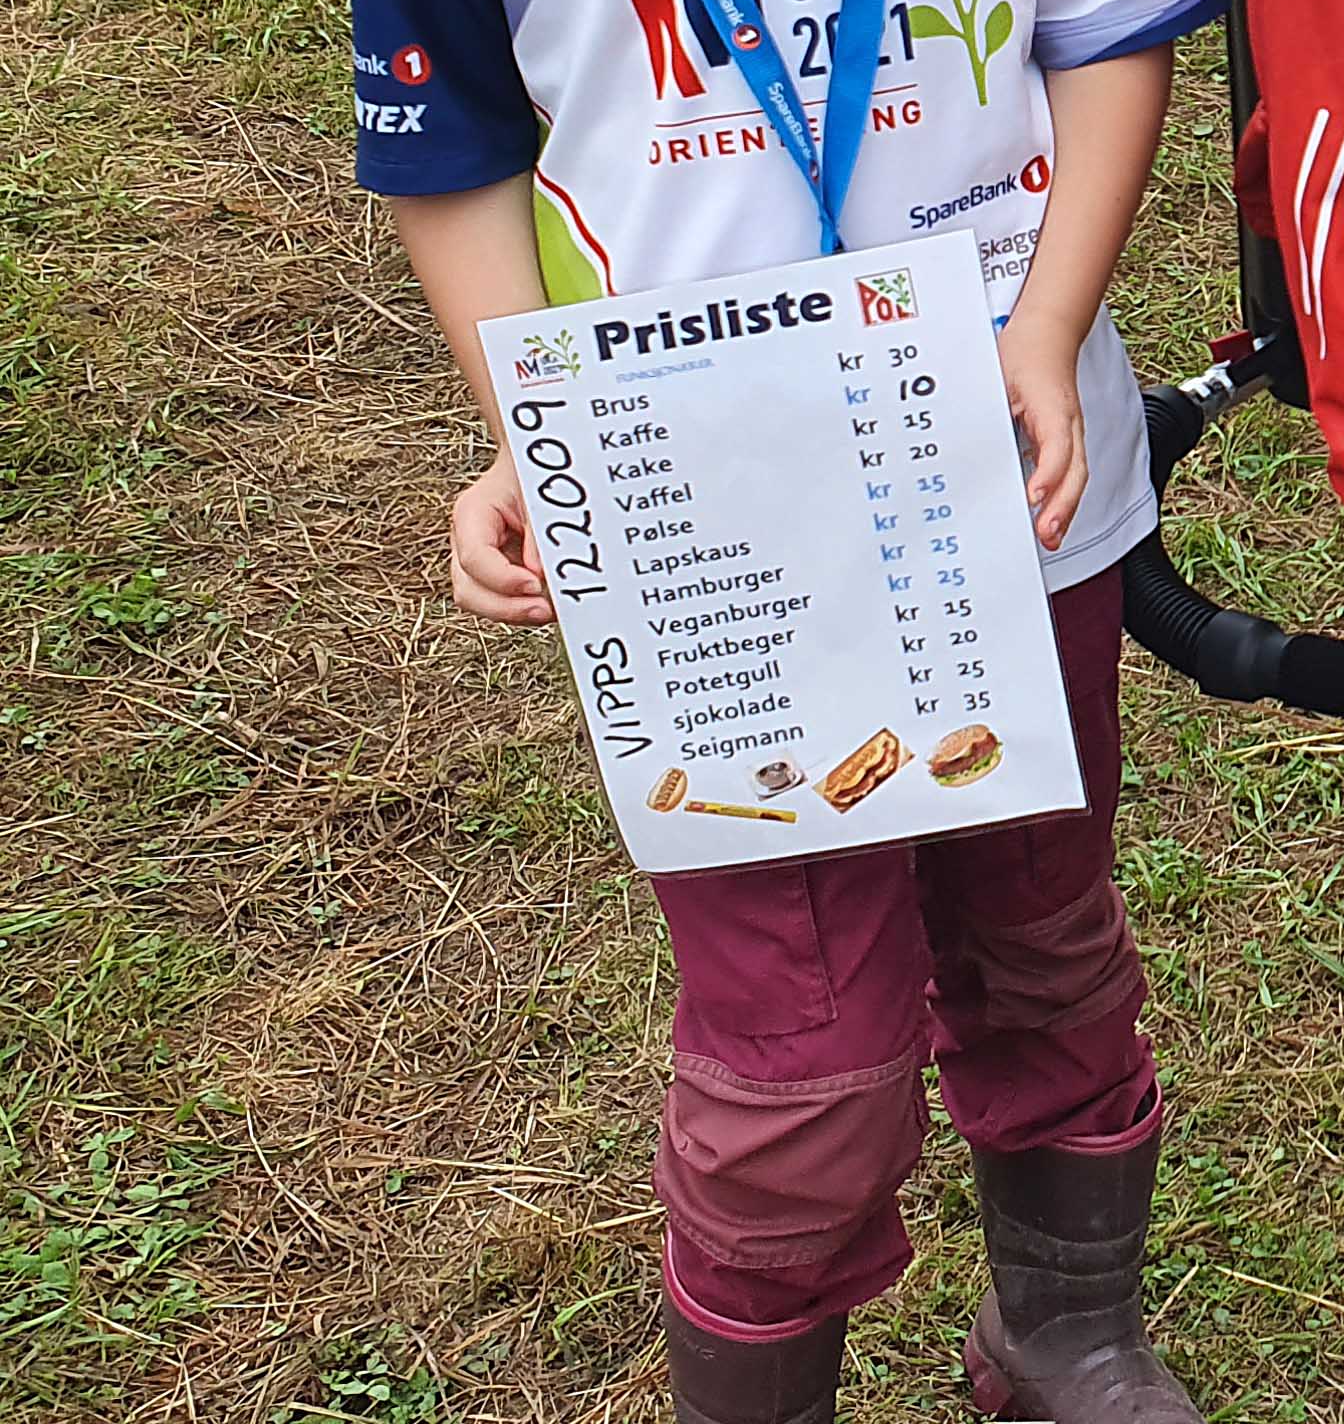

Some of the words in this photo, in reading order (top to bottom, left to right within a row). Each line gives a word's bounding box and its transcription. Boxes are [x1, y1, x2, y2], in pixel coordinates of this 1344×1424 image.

[404, 51, 423, 79] 1
[792, 1, 915, 78] 201
[909, 171, 1018, 230] SpareBank
[593, 290, 833, 362] Prisliste
[591, 394, 649, 418] Brus
[838, 351, 864, 372] kr
[888, 344, 918, 367] 30
[600, 423, 670, 450] Kaffe
[845, 385, 871, 405] kr
[899, 375, 936, 401] 10
[608, 456, 673, 482] Kake
[852, 416, 878, 437] kr
[903, 410, 933, 429] 15
[614, 483, 693, 513] Vaffel
[859, 448, 885, 469] kr
[909, 443, 938, 460] 20
[512, 399, 608, 603] 122009
[625, 518, 694, 545] Pølse
[866, 480, 892, 501] kr
[917, 474, 946, 493] 15
[633, 540, 751, 576] Lapskaus
[874, 512, 898, 532] kr
[924, 505, 952, 522] 20
[642, 565, 784, 607] Hamburger
[881, 542, 905, 562] kr
[931, 536, 959, 555] 25
[648, 592, 811, 637] Veganburger
[888, 573, 913, 593] kr
[938, 567, 966, 586] 25
[658, 627, 796, 668] Fruktbeger
[895, 604, 919, 624] kr
[944, 598, 972, 617] 15
[584, 636, 653, 759] VIPPS
[665, 660, 780, 698] Potetgull
[902, 634, 926, 654] kr
[949, 629, 977, 646] 20
[674, 692, 792, 734] sjokolade
[908, 665, 933, 685] kr
[957, 660, 985, 678] 25
[681, 725, 804, 761] Seigmann
[915, 695, 940, 716] kr
[963, 691, 991, 712] 35
